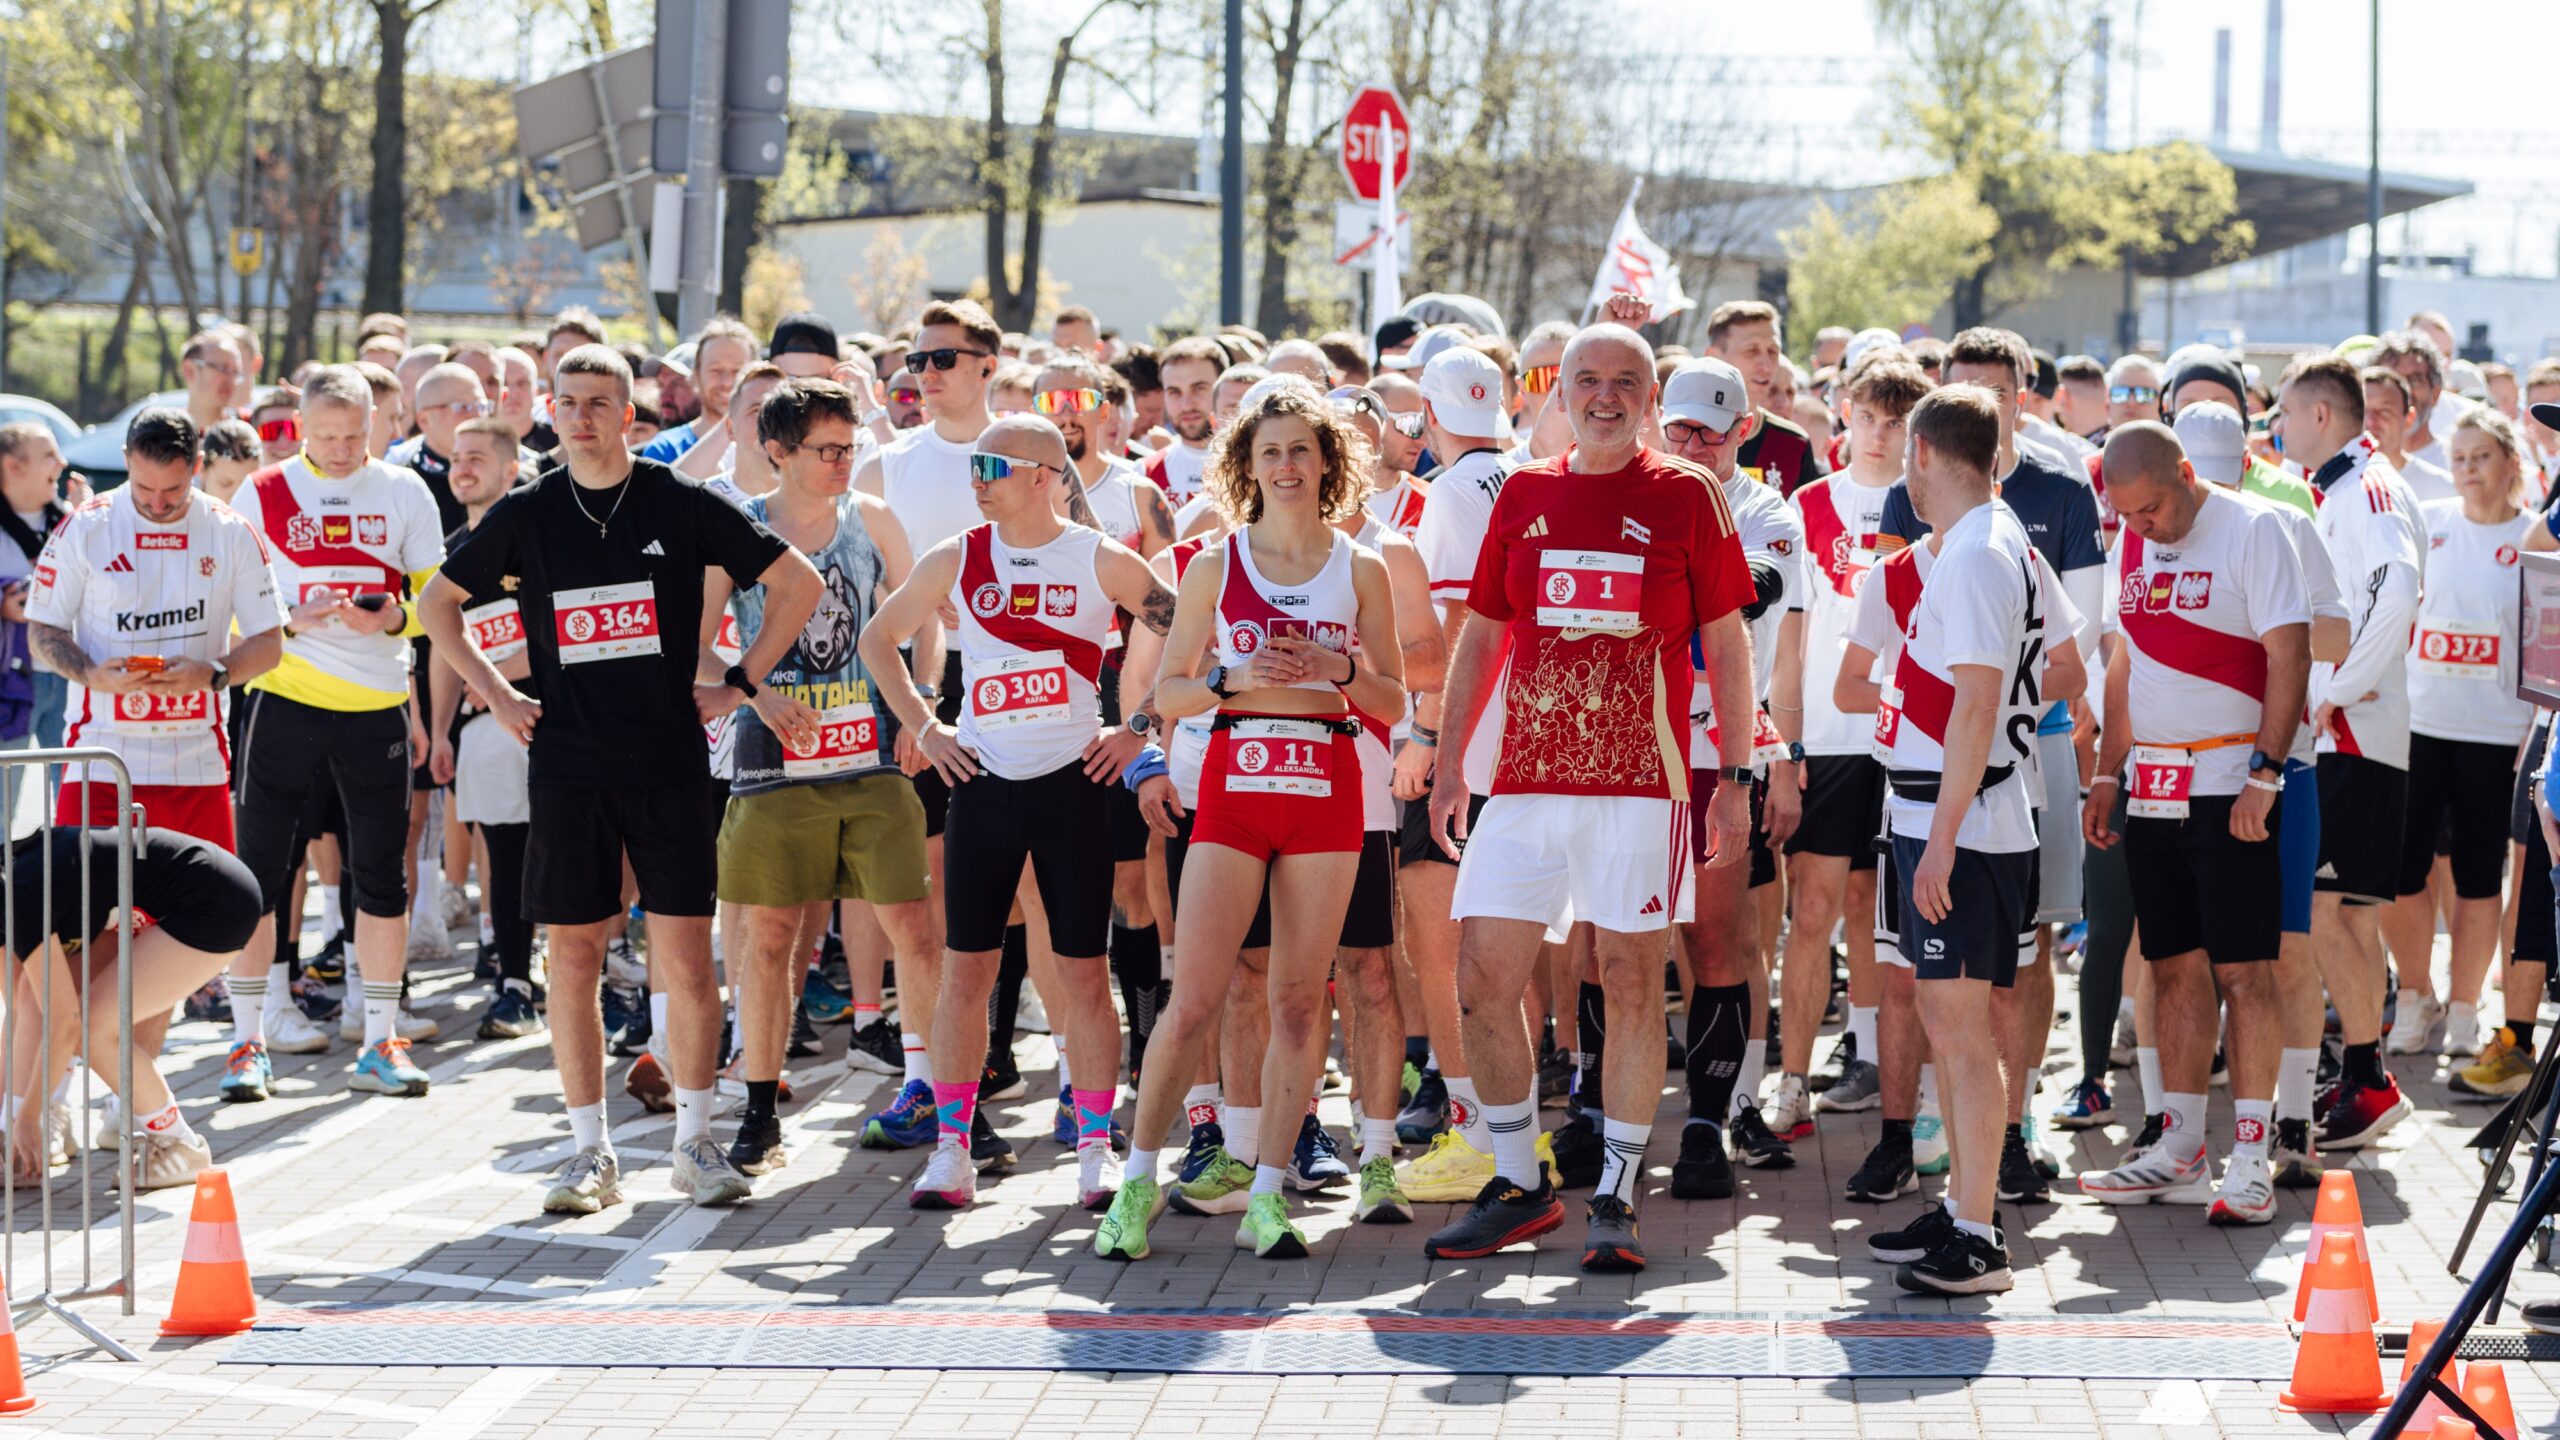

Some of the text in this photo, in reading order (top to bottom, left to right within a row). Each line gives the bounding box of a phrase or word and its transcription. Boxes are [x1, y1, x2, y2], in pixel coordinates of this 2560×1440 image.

[140, 534, 183, 548] Betclic
[1599, 576, 1614, 599] 1
[116, 599, 205, 632] Kramel
[599, 604, 650, 630] 364
[483, 615, 518, 641] 355
[610, 627, 644, 637] BARTOSZ
[2451, 635, 2493, 658] 373
[1010, 671, 1061, 699] 300
[825, 722, 872, 749] 208
[1285, 743, 1316, 766] 11
[1274, 765, 1325, 775] ALEKSANDRA
[2149, 768, 2178, 790] 12
